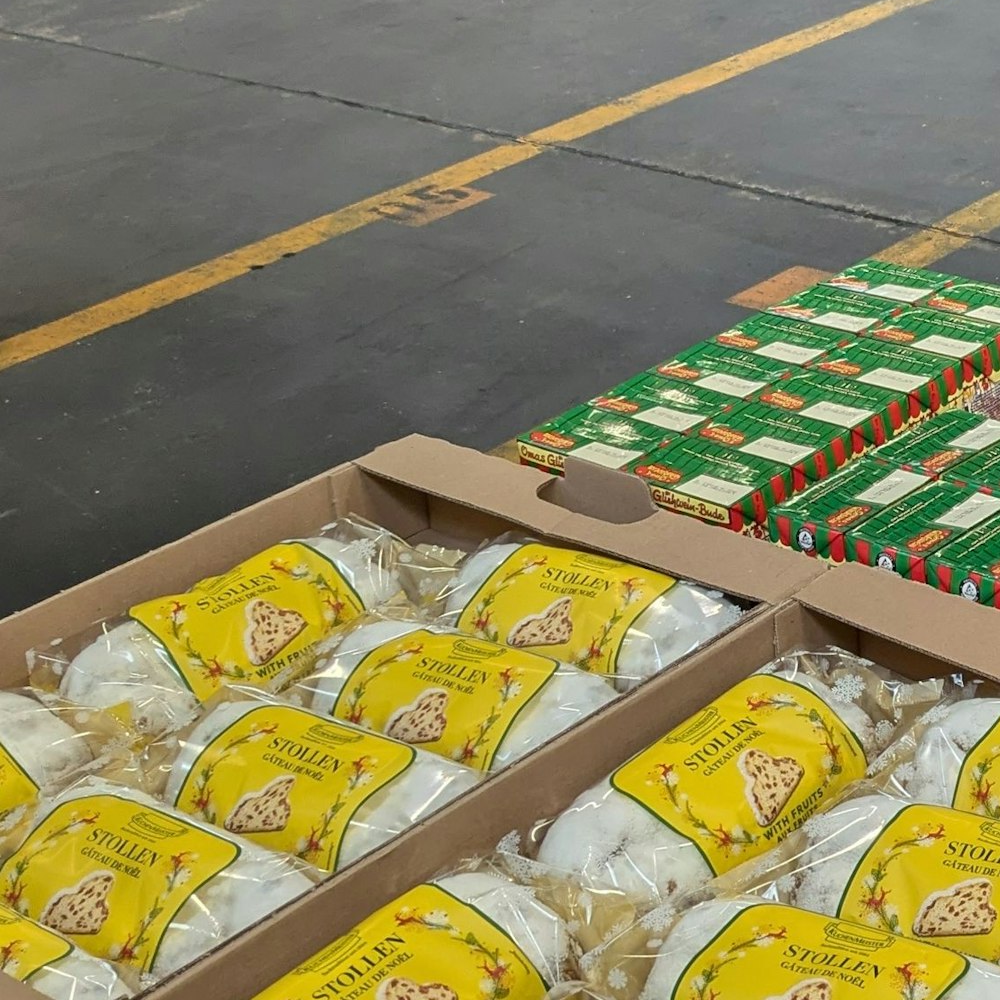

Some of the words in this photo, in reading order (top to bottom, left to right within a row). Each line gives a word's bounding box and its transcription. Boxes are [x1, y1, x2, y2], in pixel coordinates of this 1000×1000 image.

[521, 444, 546, 464] Omas
[653, 489, 725, 521] Glühwein-Bude
[196, 572, 276, 611] STOLLEN
[542, 567, 614, 592] STOLLEN
[568, 586, 578, 595] DE
[255, 658, 286, 679] WITH
[416, 657, 491, 684] STOLLEN
[443, 679, 454, 689] DE
[267, 737, 344, 773] STOLLEN
[683, 716, 758, 771] STOLLEN
[262, 752, 294, 770] GÂTEAU
[703, 749, 735, 777] GÂTEAU
[734, 741, 745, 754] DE
[763, 818, 789, 841] WITH
[791, 790, 824, 820] FRUITS
[80, 846, 112, 866] GÂTEAU
[86, 828, 163, 868] STOLLEN
[942, 859, 982, 874] GÂTEAU
[982, 868, 996, 877] DE
[312, 932, 406, 1000] STOLLEN
[374, 969, 387, 983] DE
[387, 951, 413, 973] NOËL
[780, 961, 820, 976] GÂTEAU
[822, 969, 836, 978] DE
[836, 972, 865, 989] NOËL
[783, 944, 886, 979] STOLLEN
